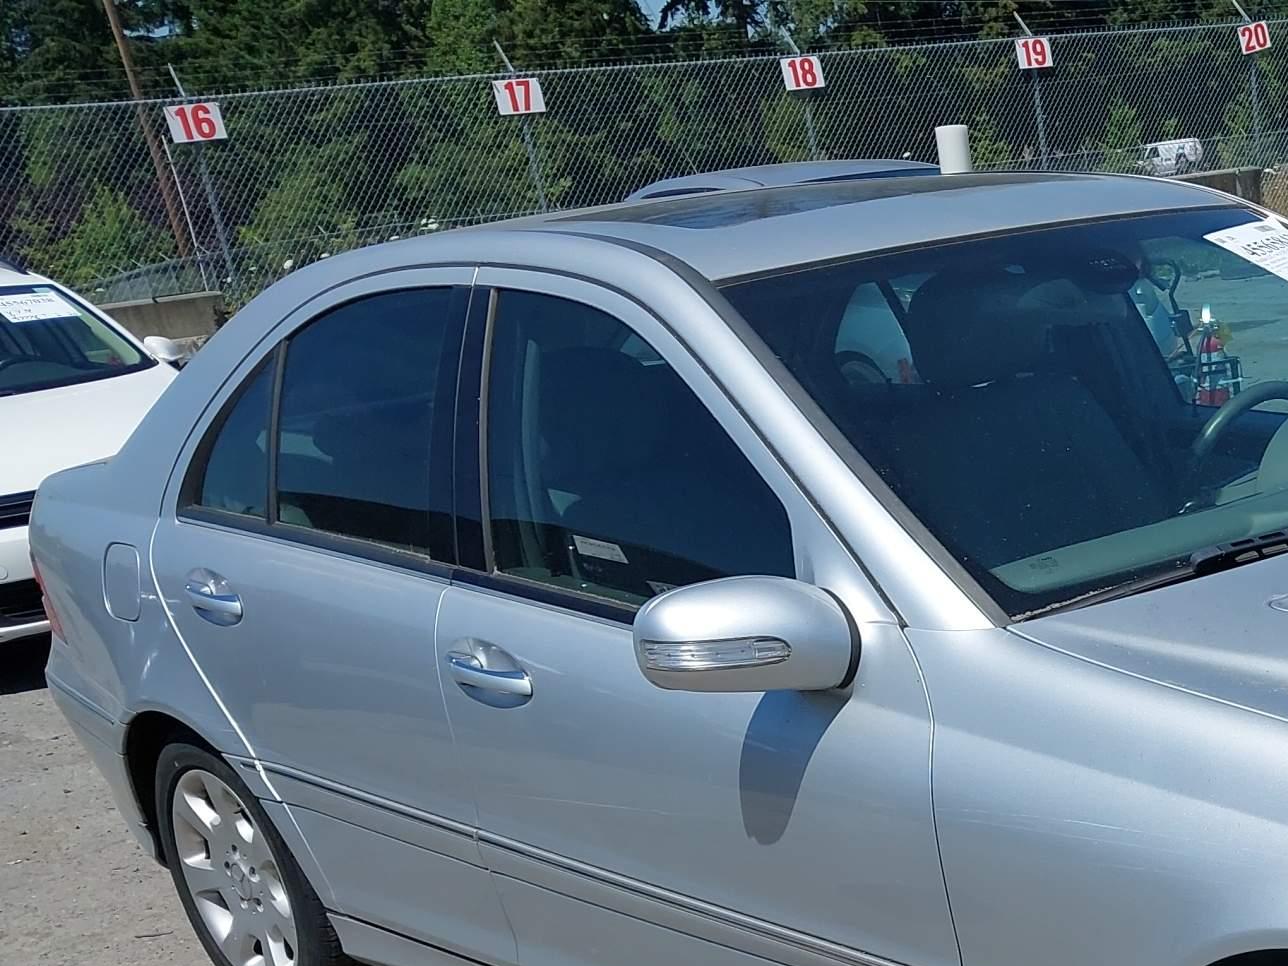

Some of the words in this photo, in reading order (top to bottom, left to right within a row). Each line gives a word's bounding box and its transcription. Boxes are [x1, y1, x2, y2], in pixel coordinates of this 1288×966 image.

[1240, 23, 1267, 51] 20
[1022, 39, 1047, 66] 19
[788, 58, 817, 87] 18
[504, 80, 531, 112] 17
[175, 104, 216, 140] 16
